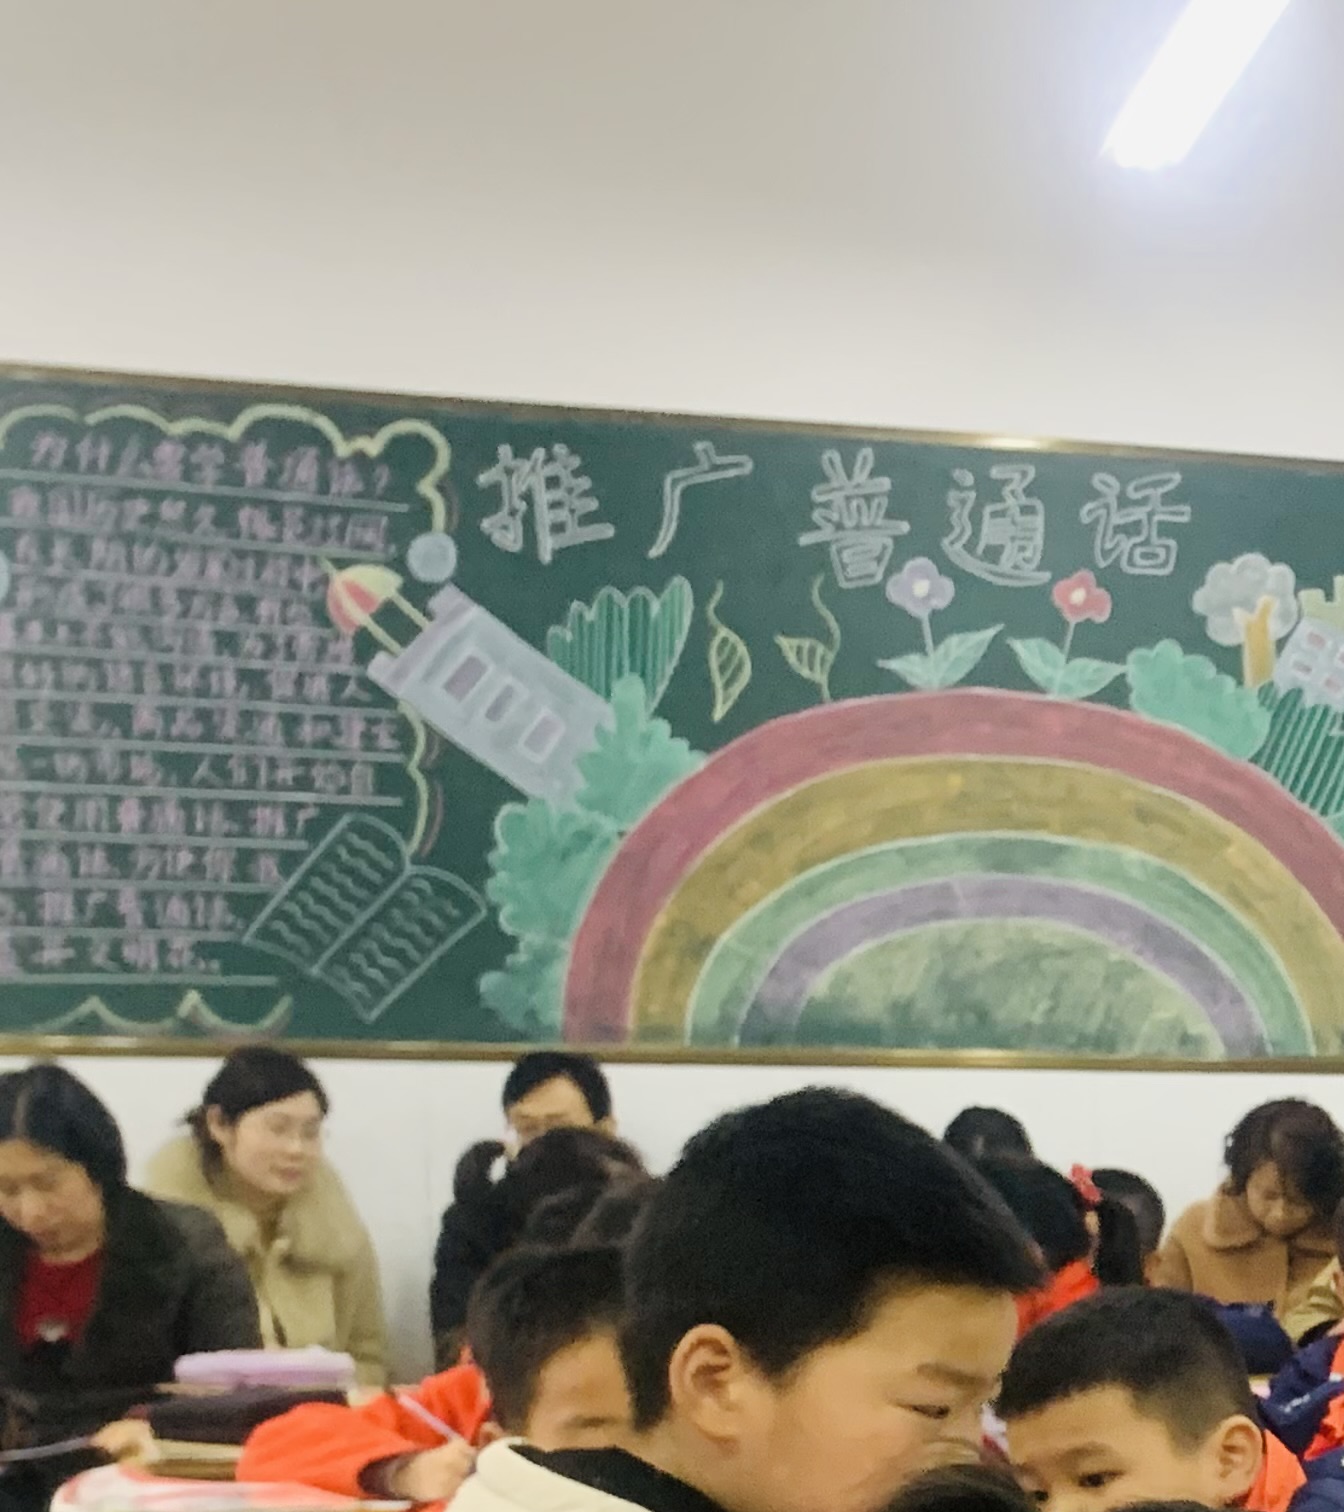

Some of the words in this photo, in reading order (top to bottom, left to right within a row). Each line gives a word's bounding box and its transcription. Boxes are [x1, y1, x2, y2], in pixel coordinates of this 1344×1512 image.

[476, 441, 1192, 588] 推广普通话
